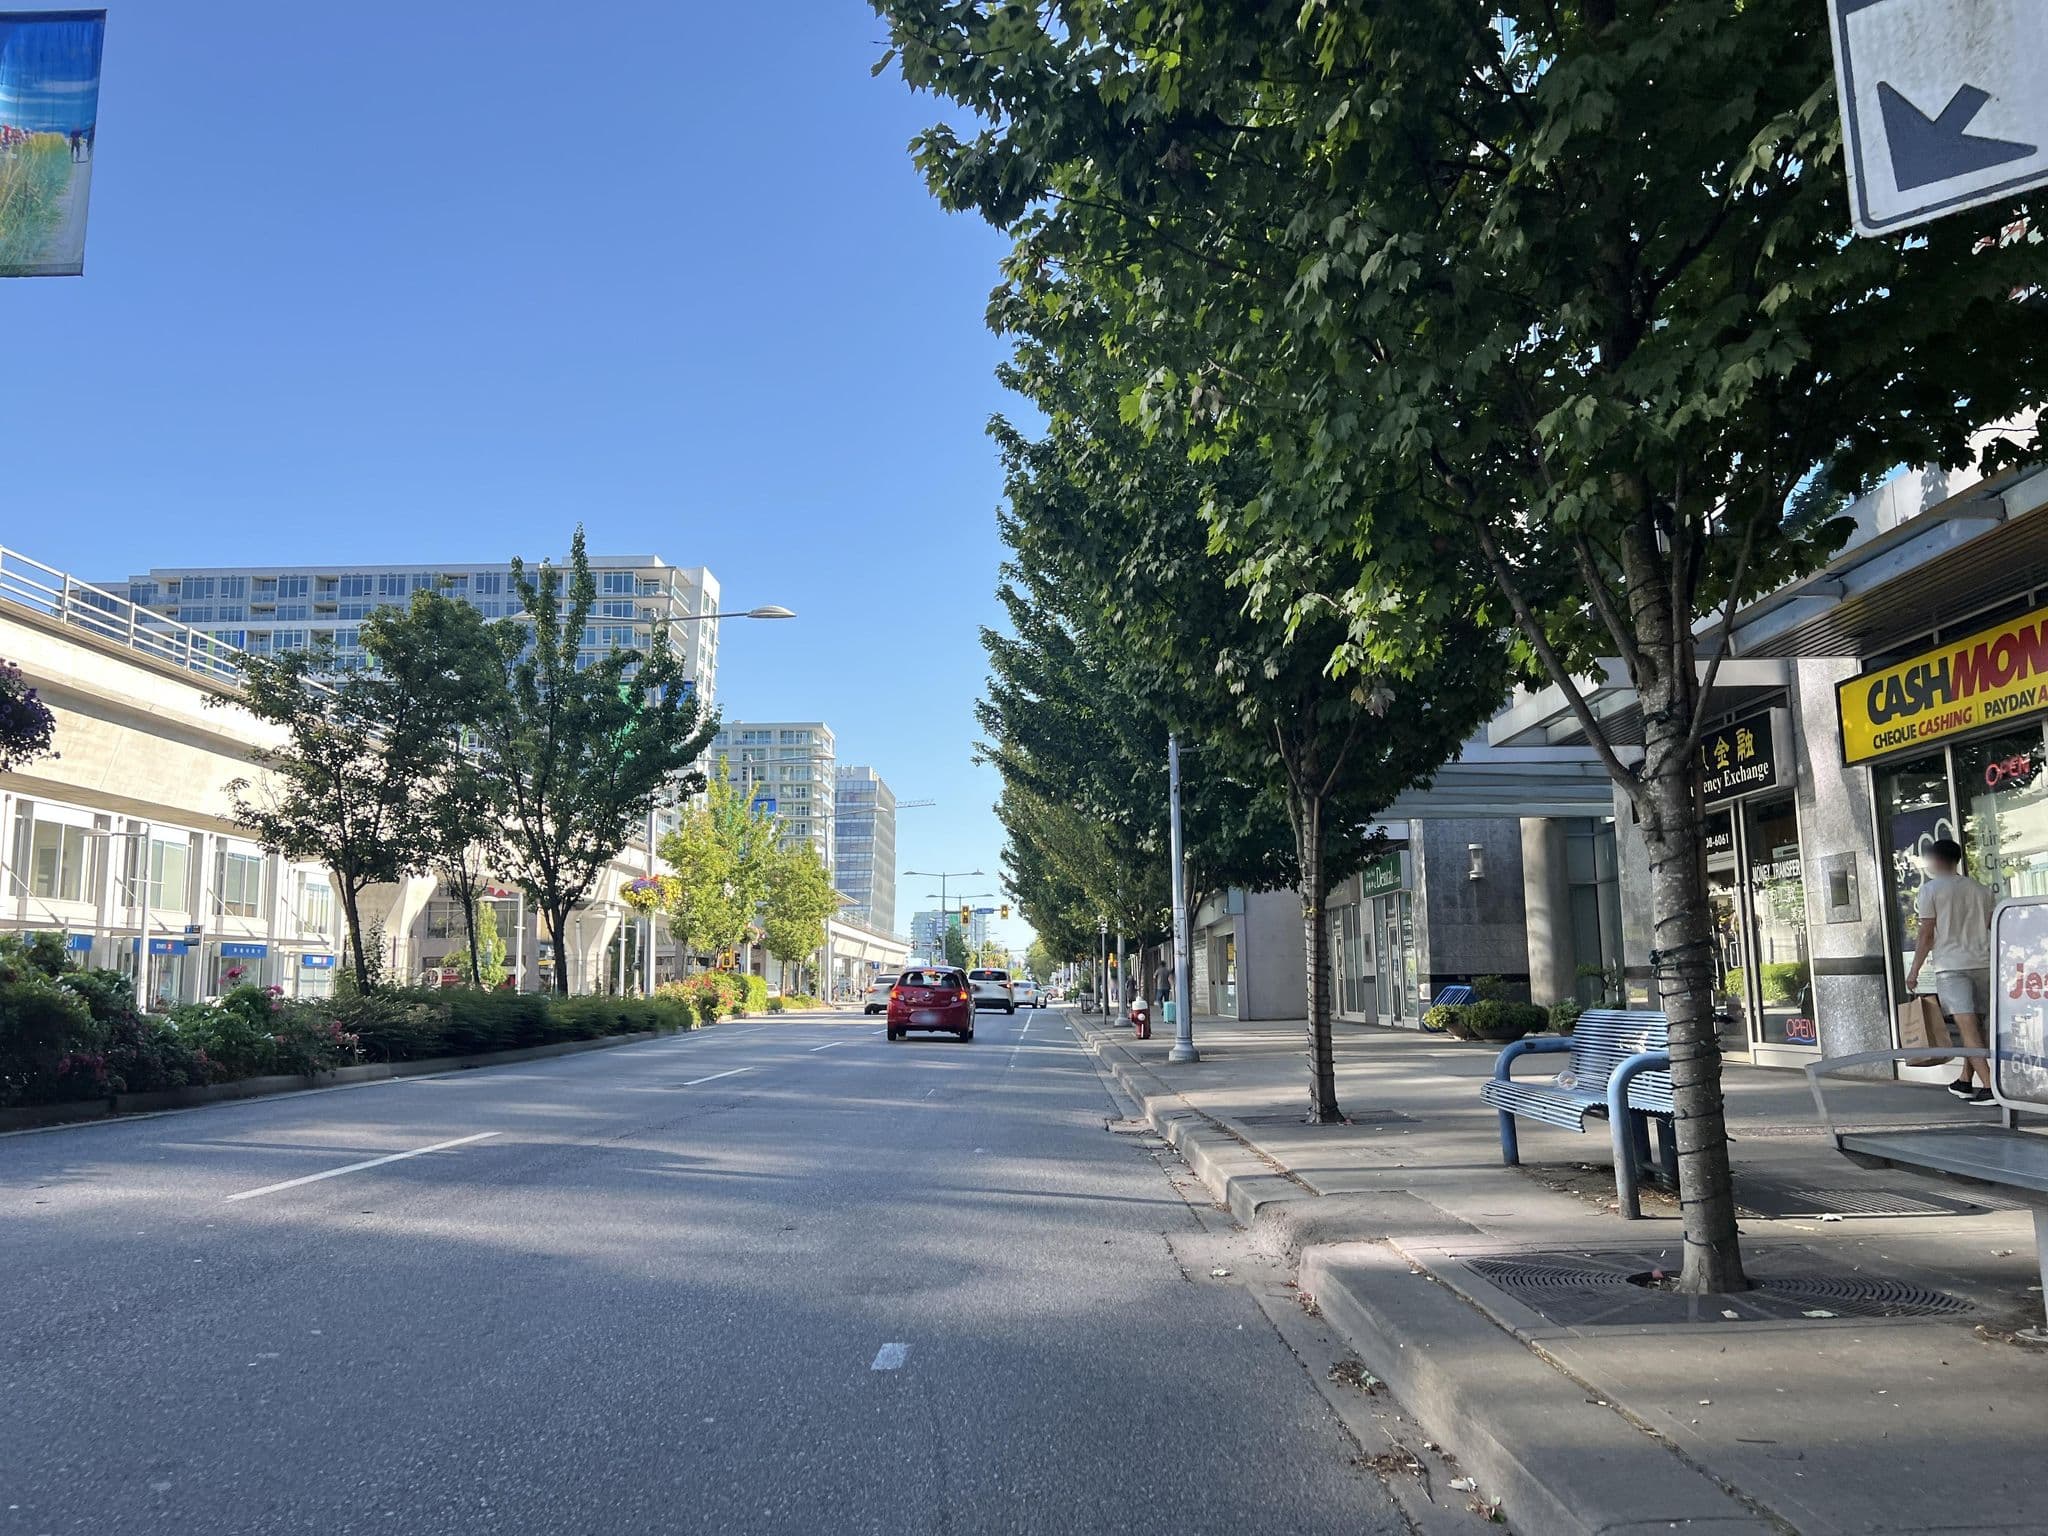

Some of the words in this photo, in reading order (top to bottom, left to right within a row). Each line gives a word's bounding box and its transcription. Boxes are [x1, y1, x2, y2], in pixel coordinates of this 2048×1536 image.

[1873, 724, 1917, 749] CHEQUE
[1918, 706, 1973, 736] CASHING
[1984, 687, 2037, 719] PAYDAY
[1701, 728, 1755, 771] 金融
[1724, 762, 1769, 788] Exchange
[1786, 1018, 1815, 1038] OPEN
